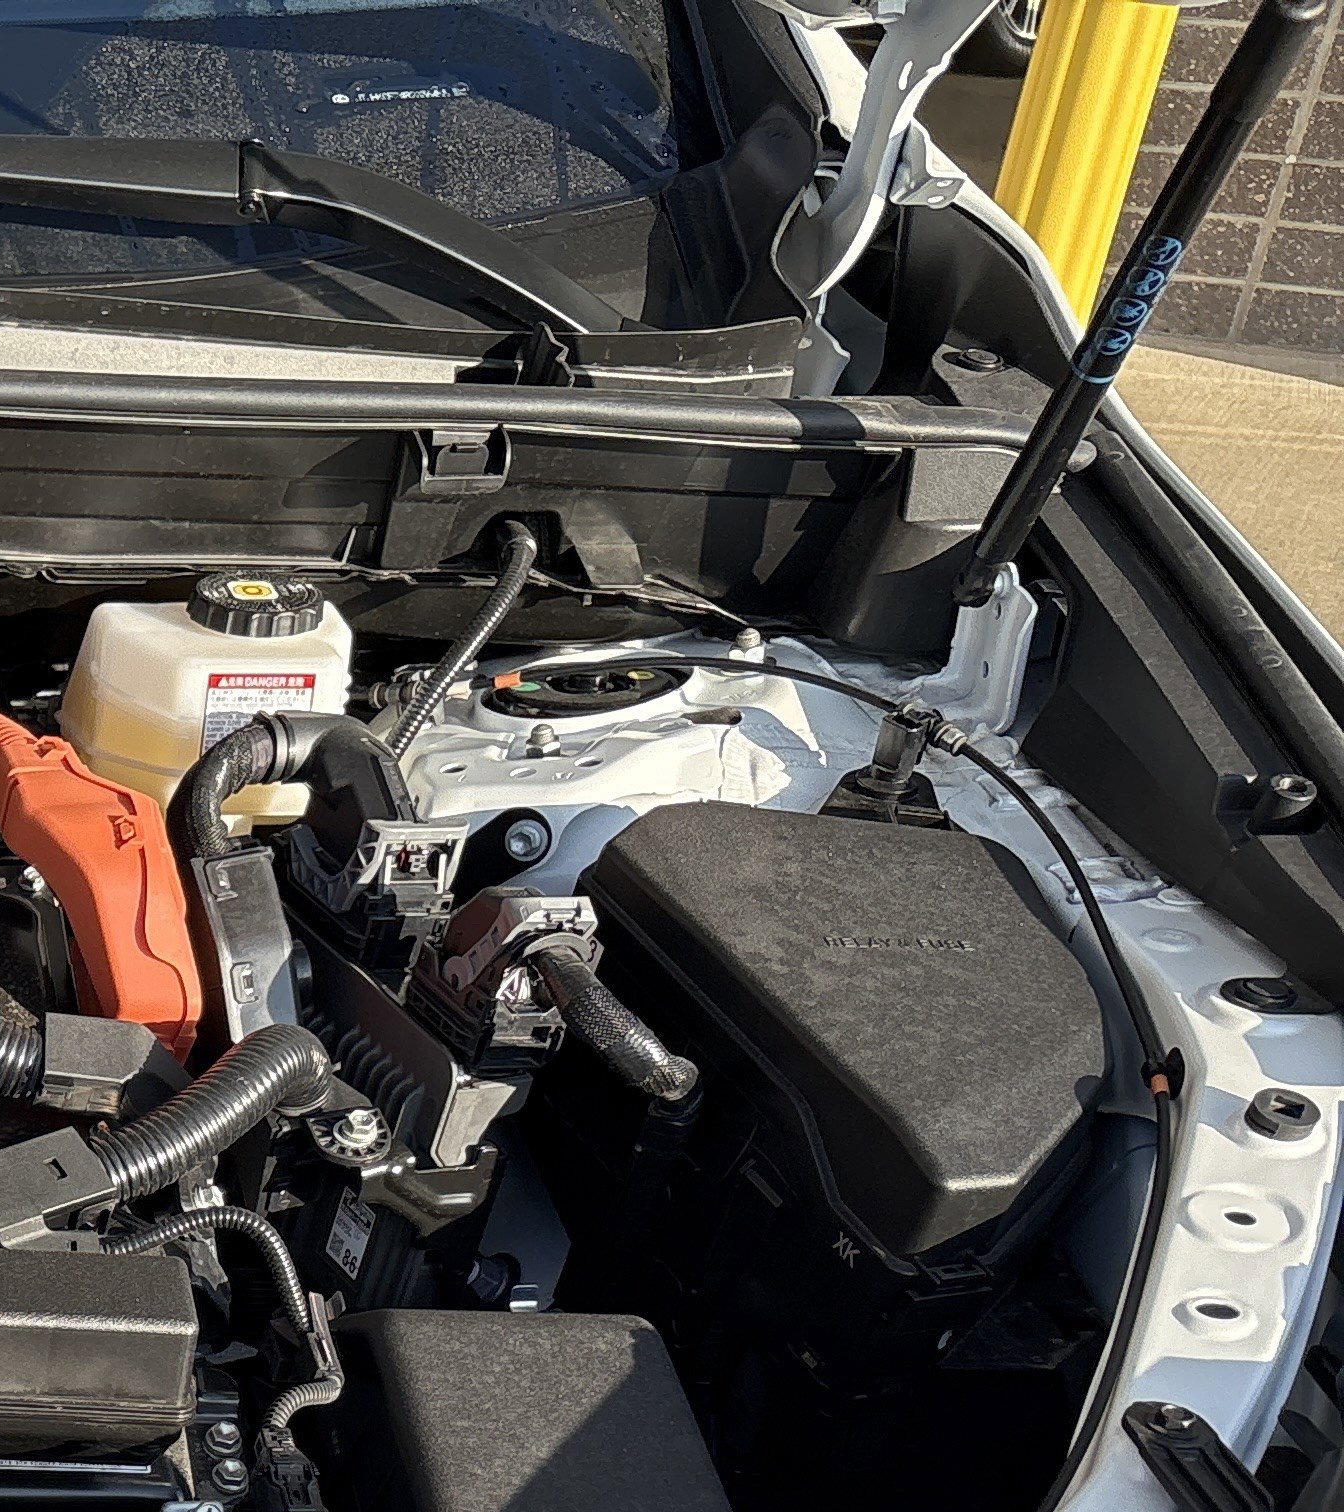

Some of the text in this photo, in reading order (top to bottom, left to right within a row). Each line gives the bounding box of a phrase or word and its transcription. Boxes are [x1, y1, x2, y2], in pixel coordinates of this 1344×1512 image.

[245, 677, 286, 687] DANGER
[823, 936, 890, 950] RELAY
[915, 938, 975, 951] FUSE
[832, 1230, 861, 1269] XK
